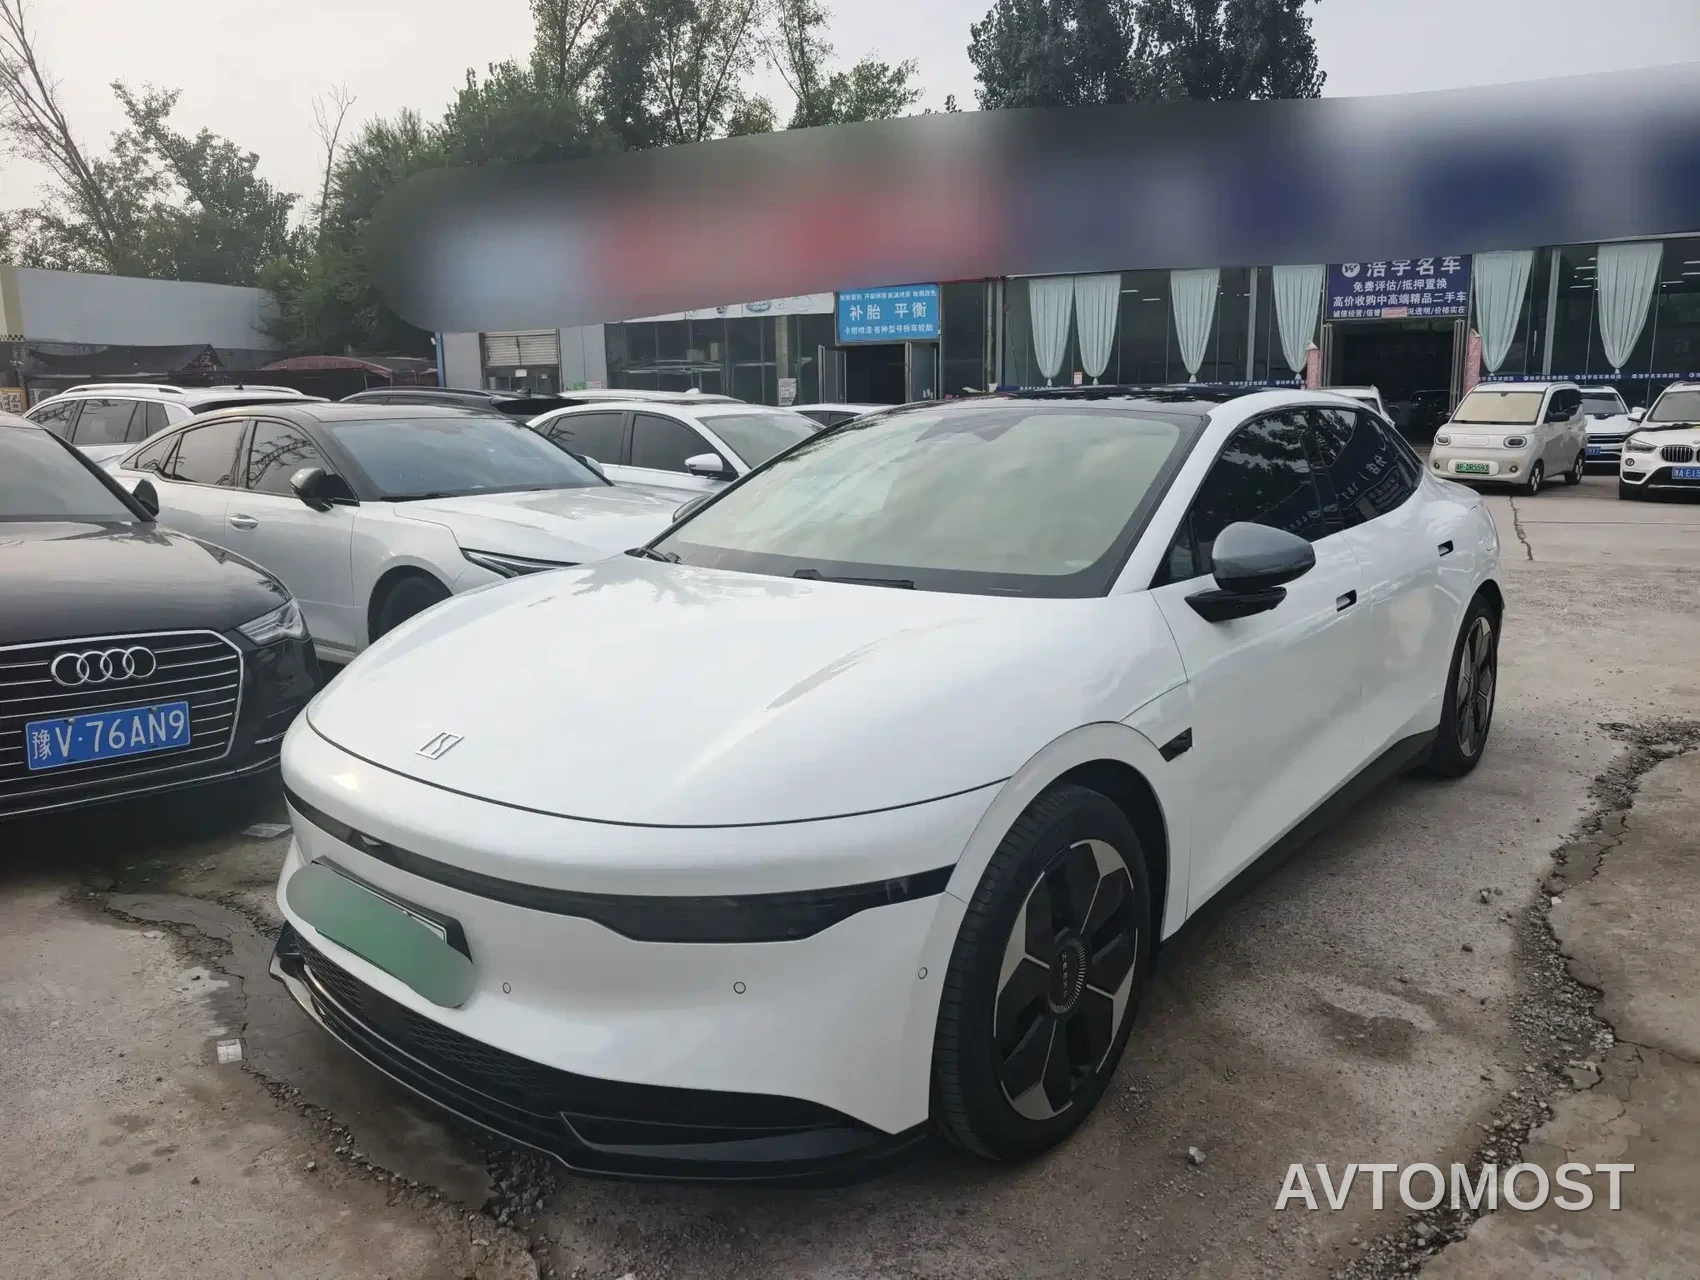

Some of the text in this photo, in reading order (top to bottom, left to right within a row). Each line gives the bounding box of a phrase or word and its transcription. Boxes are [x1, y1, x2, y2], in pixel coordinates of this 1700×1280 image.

[1367, 256, 1461, 277] 浩宇名车
[1353, 278, 1447, 293] 免费评估/抵押置换
[1333, 291, 1467, 307] 高价收购中高端精品二手车
[849, 301, 927, 321] 补胎 平衡
